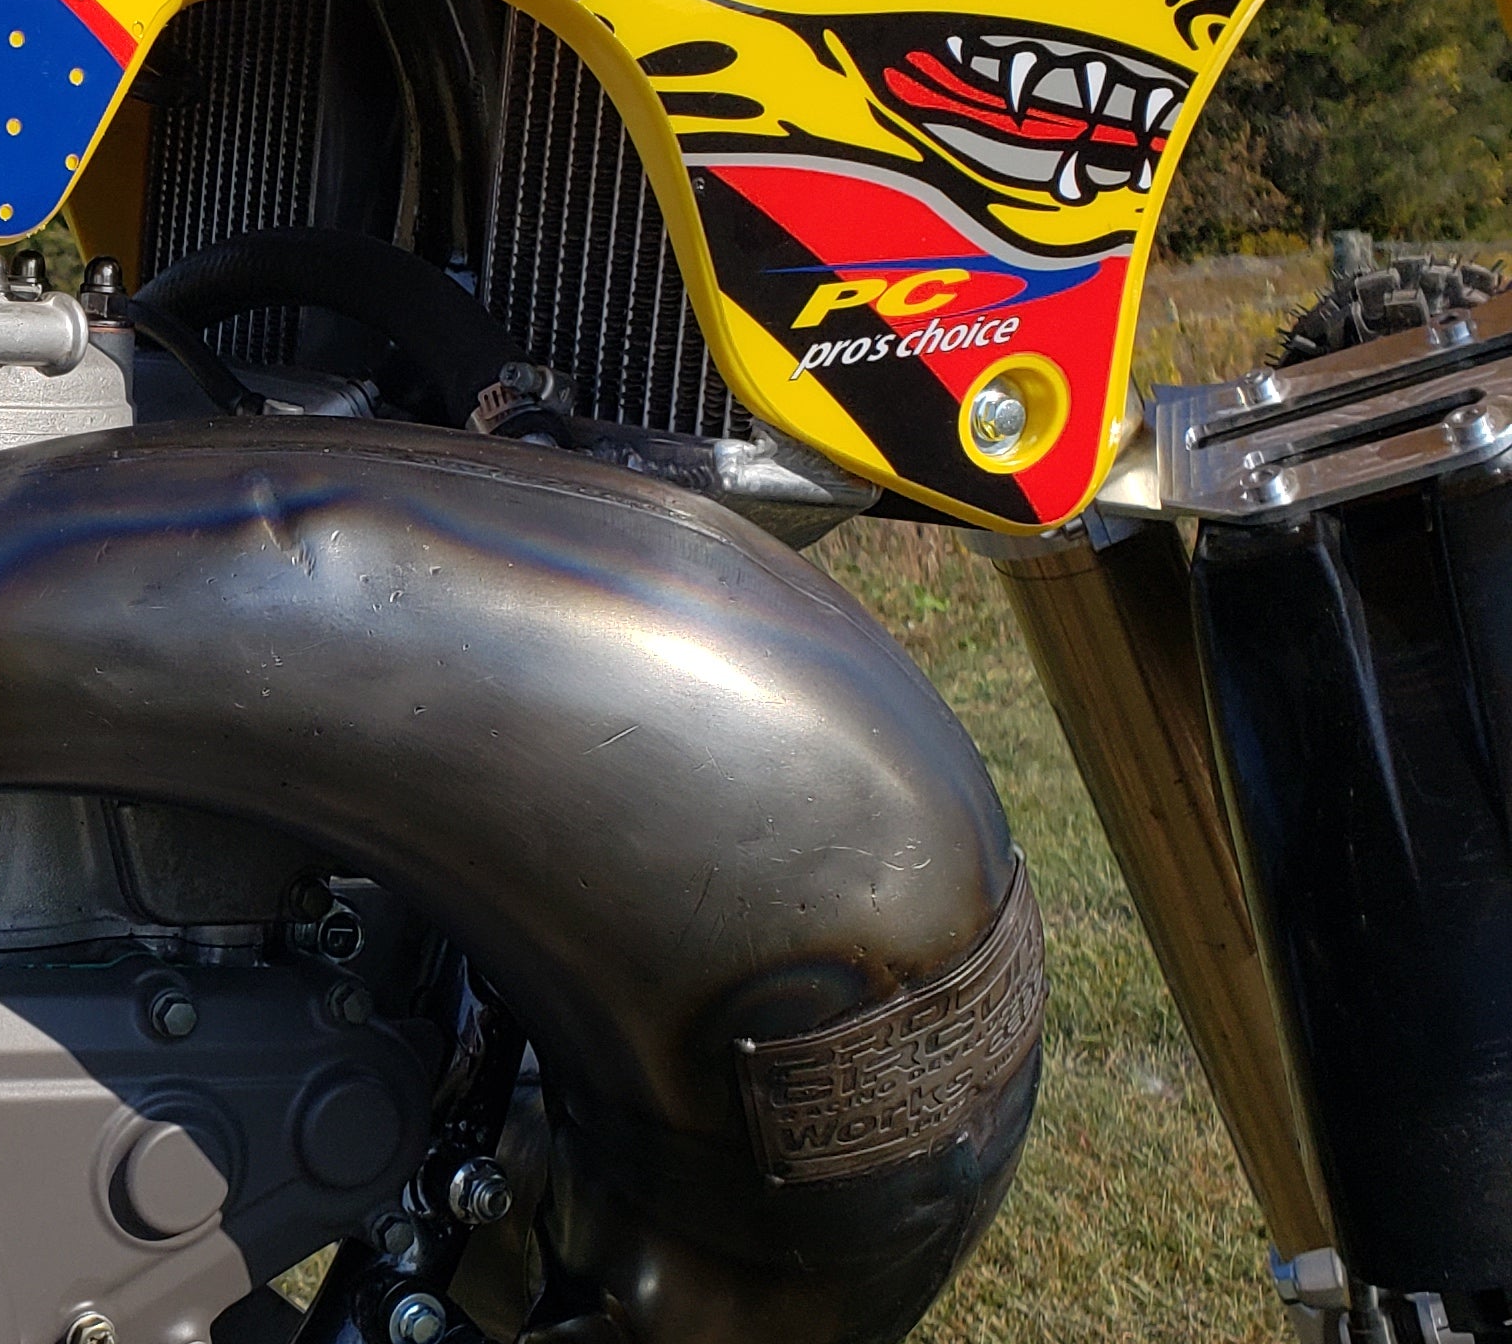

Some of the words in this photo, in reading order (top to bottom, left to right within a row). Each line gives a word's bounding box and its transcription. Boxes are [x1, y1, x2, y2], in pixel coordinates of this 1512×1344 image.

[790, 268, 971, 329] PC
[789, 334, 896, 381] pro's
[896, 317, 1020, 358] choice
